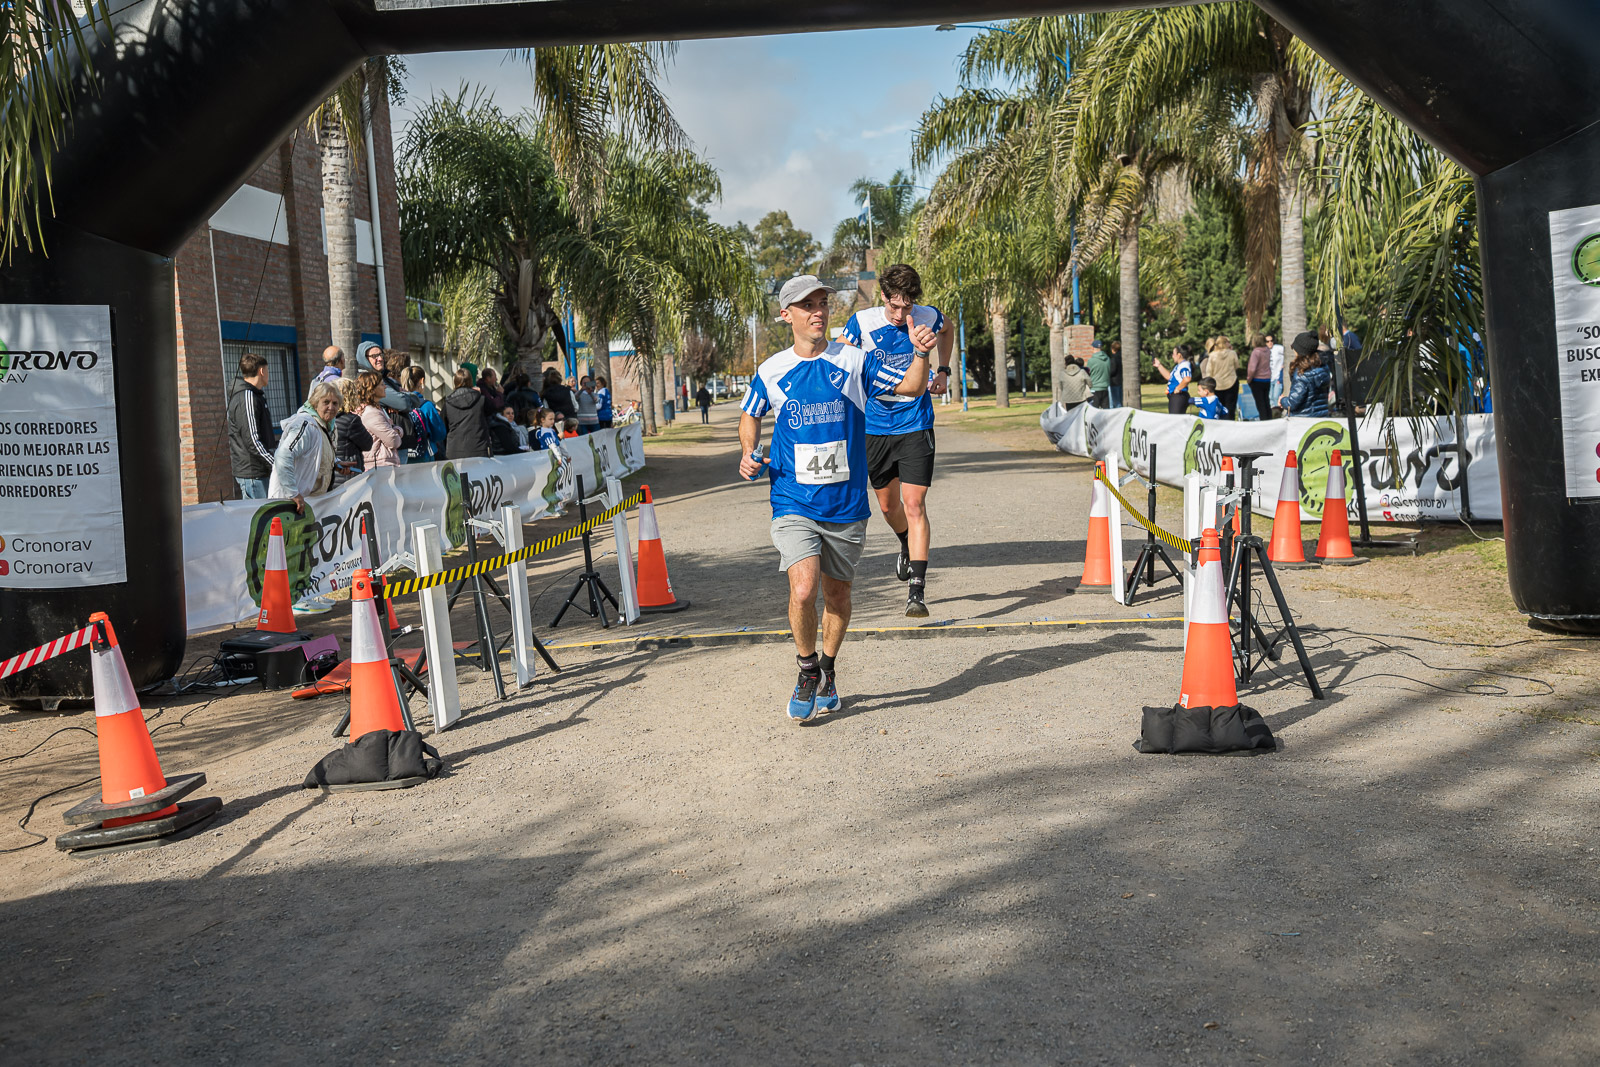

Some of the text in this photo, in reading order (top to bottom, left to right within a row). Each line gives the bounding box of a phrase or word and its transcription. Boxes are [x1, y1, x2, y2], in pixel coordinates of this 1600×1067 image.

[786, 399, 803, 430] 3
[14, 421, 98, 435] CORREDORES
[23, 442, 84, 456] MEJORAR
[87, 441, 110, 454] LAS
[56, 464, 73, 476] DE
[76, 463, 100, 476] LOS
[806, 454, 838, 474] 44
[12, 538, 92, 553] Cronorav
[13, 560, 93, 575] Cronorav
